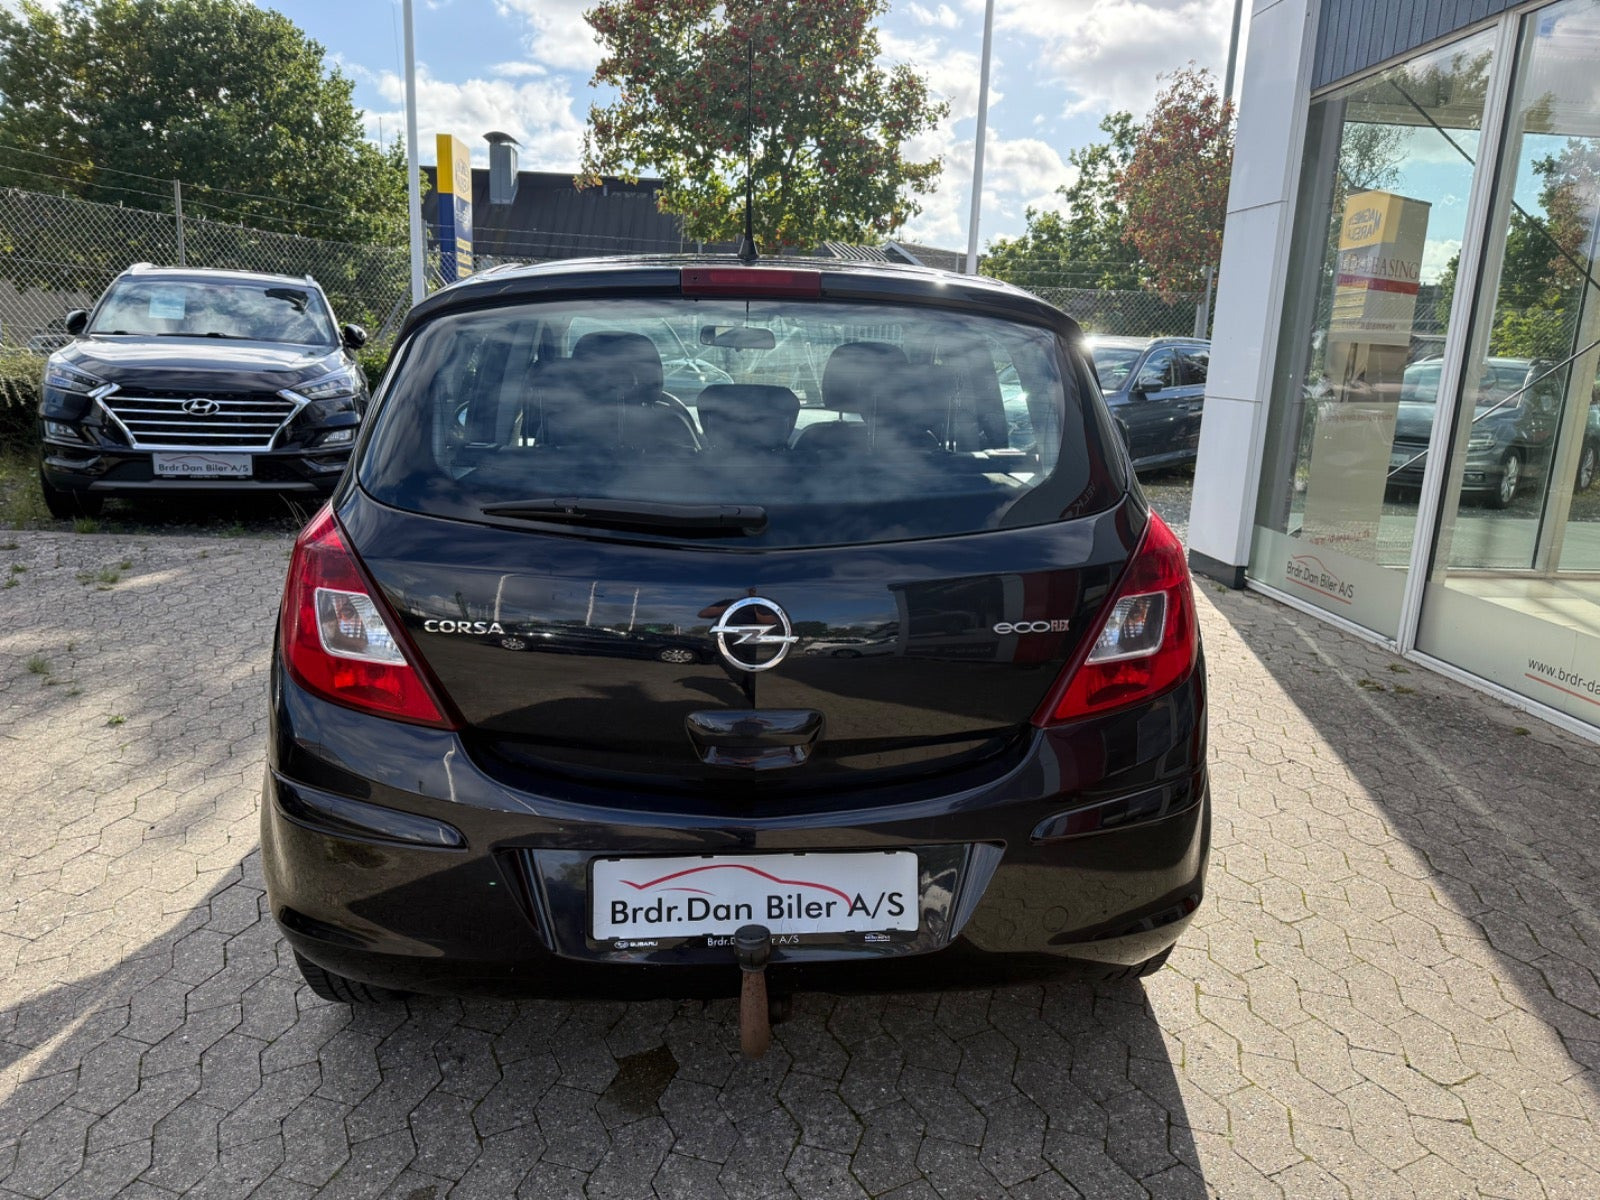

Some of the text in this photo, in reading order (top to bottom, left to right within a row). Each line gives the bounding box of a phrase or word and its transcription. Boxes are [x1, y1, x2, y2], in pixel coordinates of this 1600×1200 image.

[1320, 573, 1338, 592] Biler
[424, 619, 506, 635] CORSA
[767, 893, 837, 919] Biler
[847, 892, 905, 919] A/S
[779, 934, 800, 944] A/S
